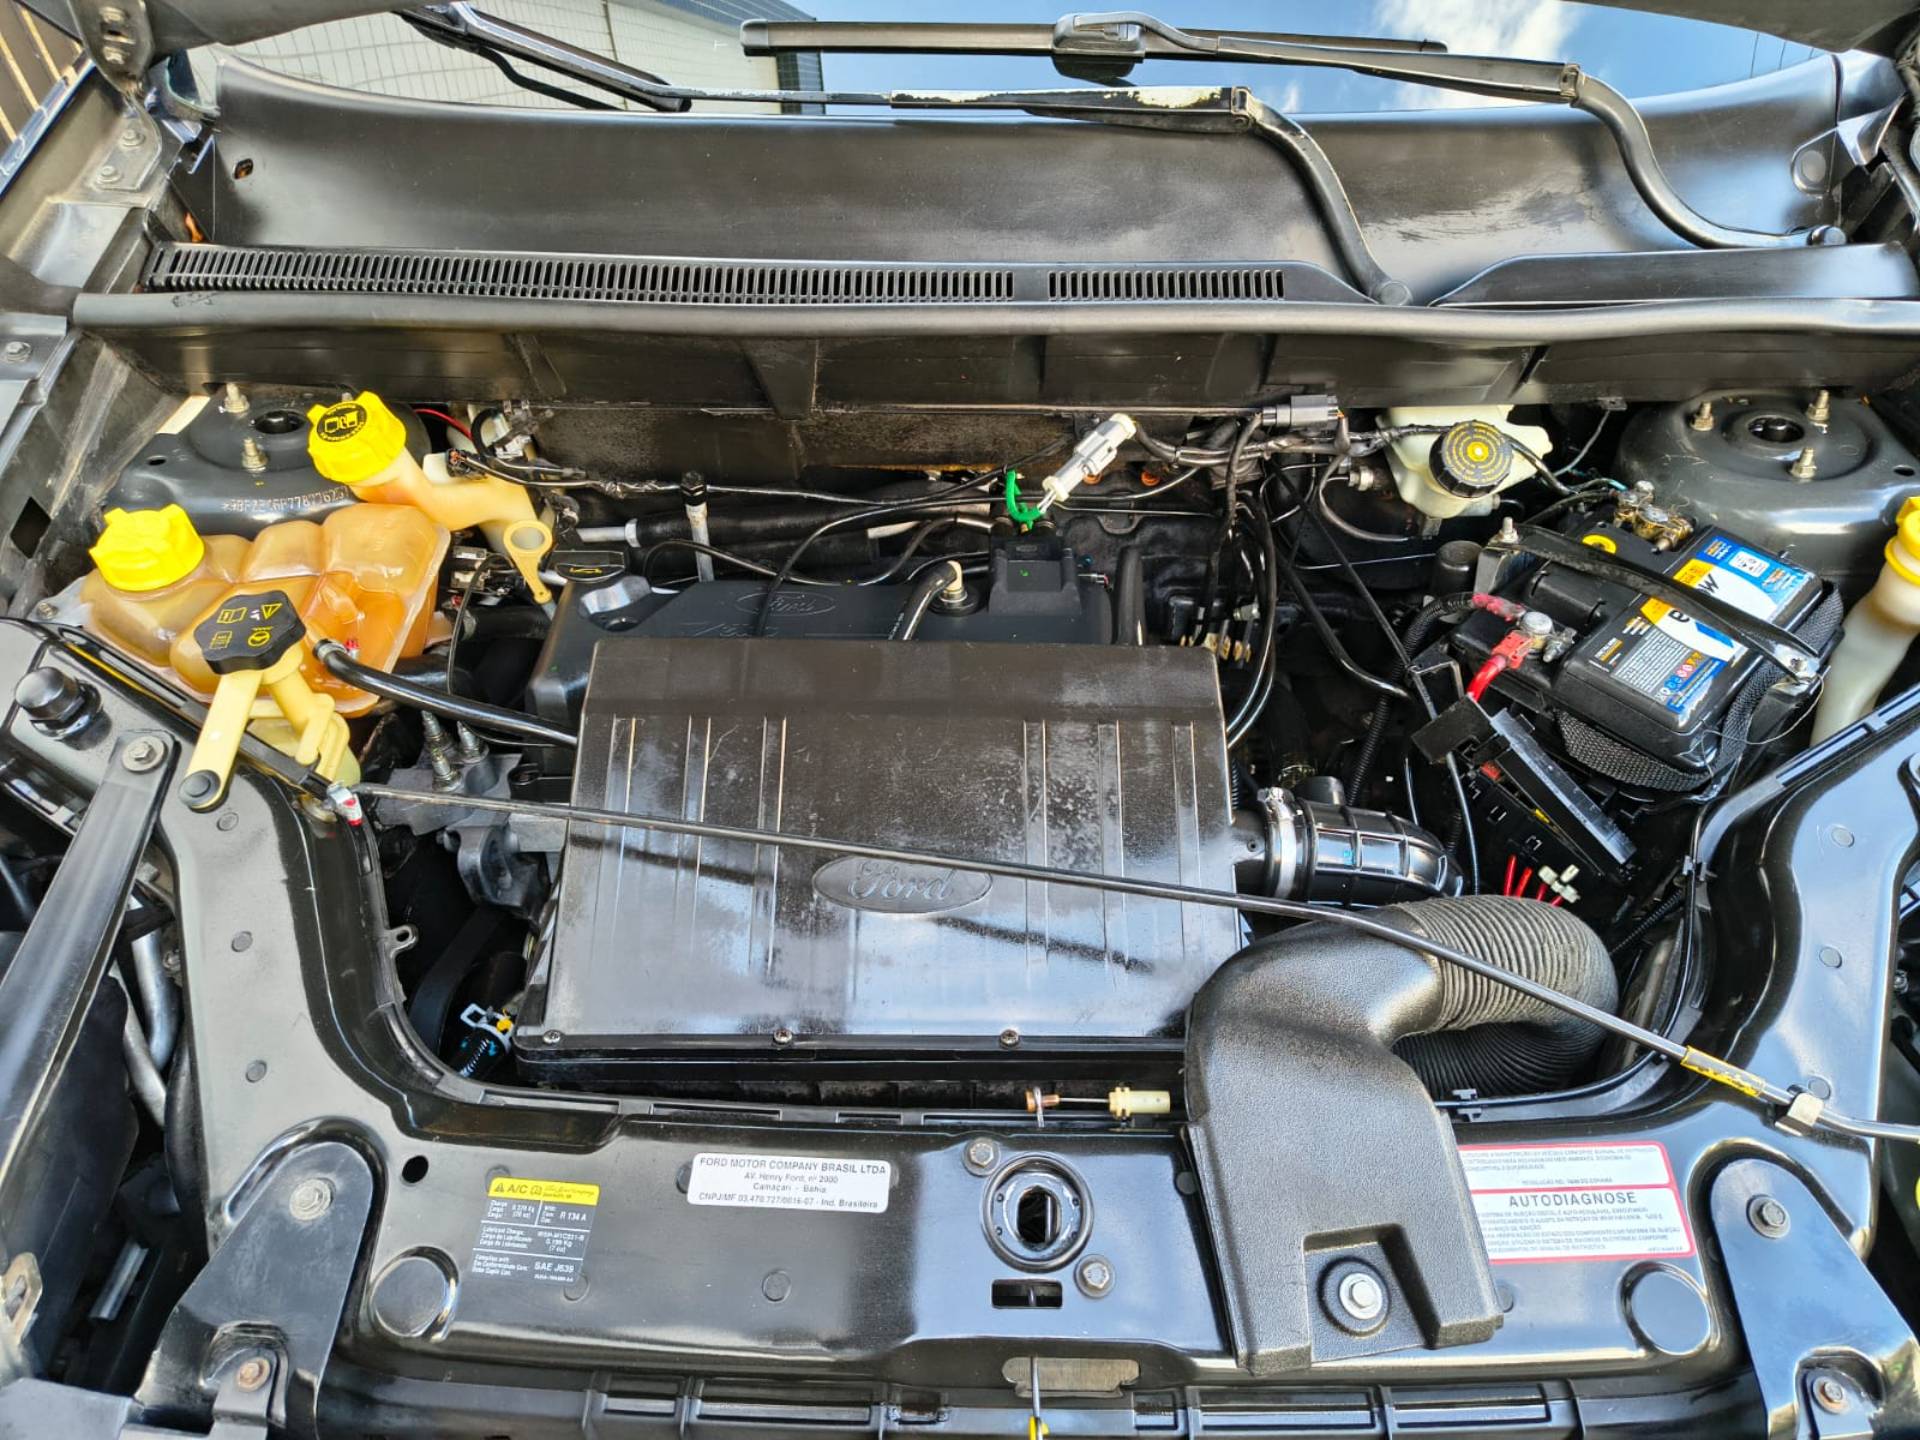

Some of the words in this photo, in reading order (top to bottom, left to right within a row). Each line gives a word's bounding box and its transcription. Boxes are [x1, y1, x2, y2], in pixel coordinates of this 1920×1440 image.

[848, 859, 957, 900] Ford
[699, 1157, 728, 1168] FORD
[730, 1159, 767, 1170] MOTOR
[769, 1160, 819, 1172] COMPANY
[821, 1162, 857, 1175] BRASIL
[860, 1164, 886, 1175] LTDA
[759, 1173, 783, 1183] Henry
[819, 1175, 839, 1184] 2000
[507, 1185, 528, 1195] A/C
[753, 1182, 792, 1193] Camaçari
[803, 1184, 827, 1194] Bahia
[839, 1199, 878, 1209] Brasileira
[1509, 1191, 1638, 1208] AUTODIAGNOSE
[534, 1261, 553, 1272] SAE
